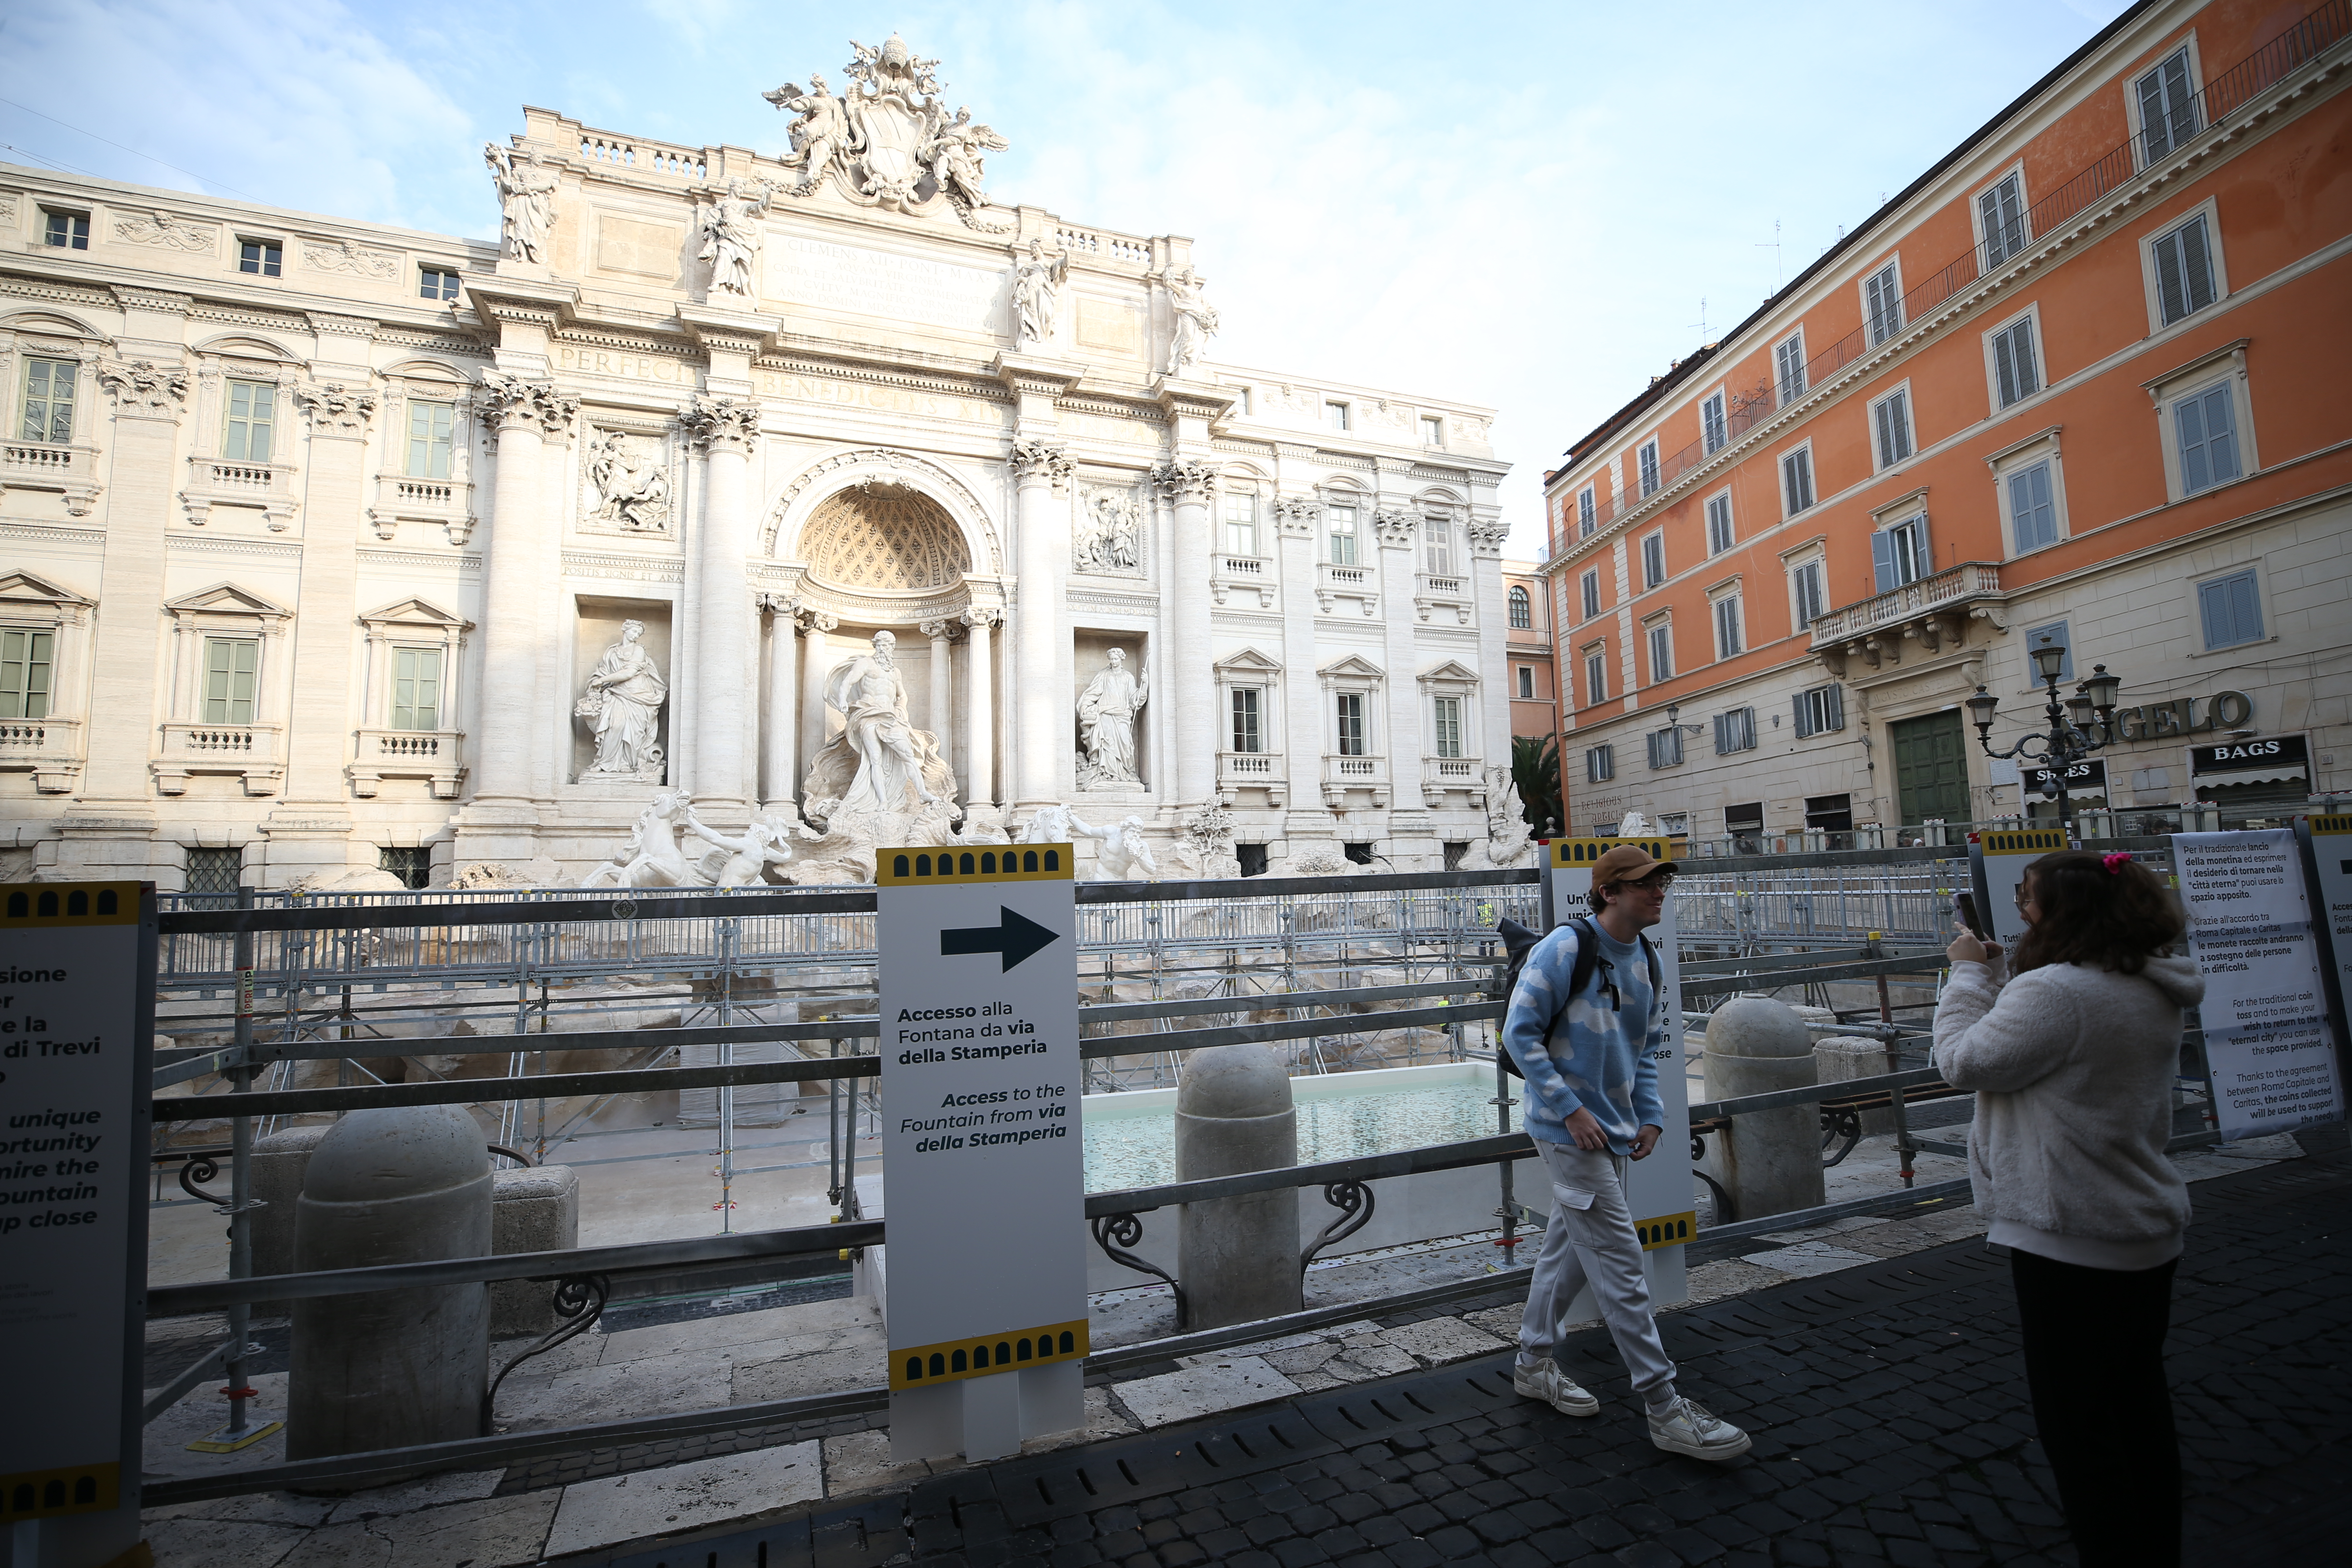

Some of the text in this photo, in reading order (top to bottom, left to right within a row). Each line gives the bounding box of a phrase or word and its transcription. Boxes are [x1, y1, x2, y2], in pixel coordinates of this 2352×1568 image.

[788, 240, 858, 260] CLEMENS
[836, 263, 942, 286] AQVAM VIRGINEM
[774, 264, 998, 307] COPIA ET SALVBRITATE COMMENDATAM
[778, 288, 813, 300] ANNO
[818, 294, 861, 308] DOMINI
[804, 280, 970, 314] CVLTV MAGNIFICO ORNAVIT
[559, 348, 703, 384] PERFECIT
[762, 375, 938, 414] BENEDICTVS
[957, 401, 1004, 422] XIV
[564, 567, 599, 576] POSITIS
[605, 570, 634, 579] SIGNIS
[1913, 675, 1963, 694] CASTELLA
[2214, 741, 2281, 760] BAGS
[2037, 764, 2091, 781] SHES
[2184, 842, 2269, 854] Per il tradizionale lancio
[2185, 853, 2286, 866] della monetina ed esprimere
[2187, 865, 2283, 877] il desiderio di tornare nella
[2189, 880, 2210, 890] "città
[2212, 879, 2239, 888] eterna"
[2241, 878, 2257, 888] puoi
[2258, 877, 2277, 886] usare
[2190, 891, 2251, 903] spazio apposito.
[2194, 913, 2269, 926] Grazie all'accordo tra
[2196, 930, 2219, 938] Roma
[2220, 926, 2251, 937] Capitale
[2259, 924, 2281, 933] Caritas
[2198, 934, 2303, 950] le monete raccolte andranno
[2207, 950, 2243, 962] sostegno
[2245, 949, 2262, 958] delle
[2264, 947, 2291, 958] persone
[2201, 961, 2249, 974] in difficoltà.
[245, 971, 253, 1009] PERI UP
[2233, 991, 2313, 1008] For the traditional coin
[897, 1001, 1013, 1023] Accesso alla
[2237, 1003, 2315, 1020] toss and to make your
[25, 1015, 47, 1032] la
[898, 1019, 1034, 1044] Fontana da via
[2243, 1014, 2318, 1031] wish to return to the
[2228, 1034, 2259, 1045] "eternal
[2261, 1032, 2278, 1043] city"
[2279, 1030, 2293, 1041] you
[2295, 1029, 2308, 1038] can
[2252, 1038, 2323, 1055] the space provided.
[4, 1036, 102, 1058] di Trevi
[898, 1039, 1047, 1065] della Stamperia
[2237, 1063, 2327, 1083] Thanks to the agreement
[2227, 1074, 2329, 1097] between Roma Capitale and
[941, 1084, 1065, 1108] Access to the
[2234, 1087, 2332, 1108] Caritas, the coins collected
[900, 1102, 1066, 1133] Fountain from via
[2250, 1099, 2333, 1119] will be used to support
[9, 1109, 102, 1130] unique
[2301, 1115, 2313, 1124] the
[916, 1123, 1066, 1153] della Stamperia
[56, 1159, 99, 1176] the
[29, 1209, 98, 1228] close
